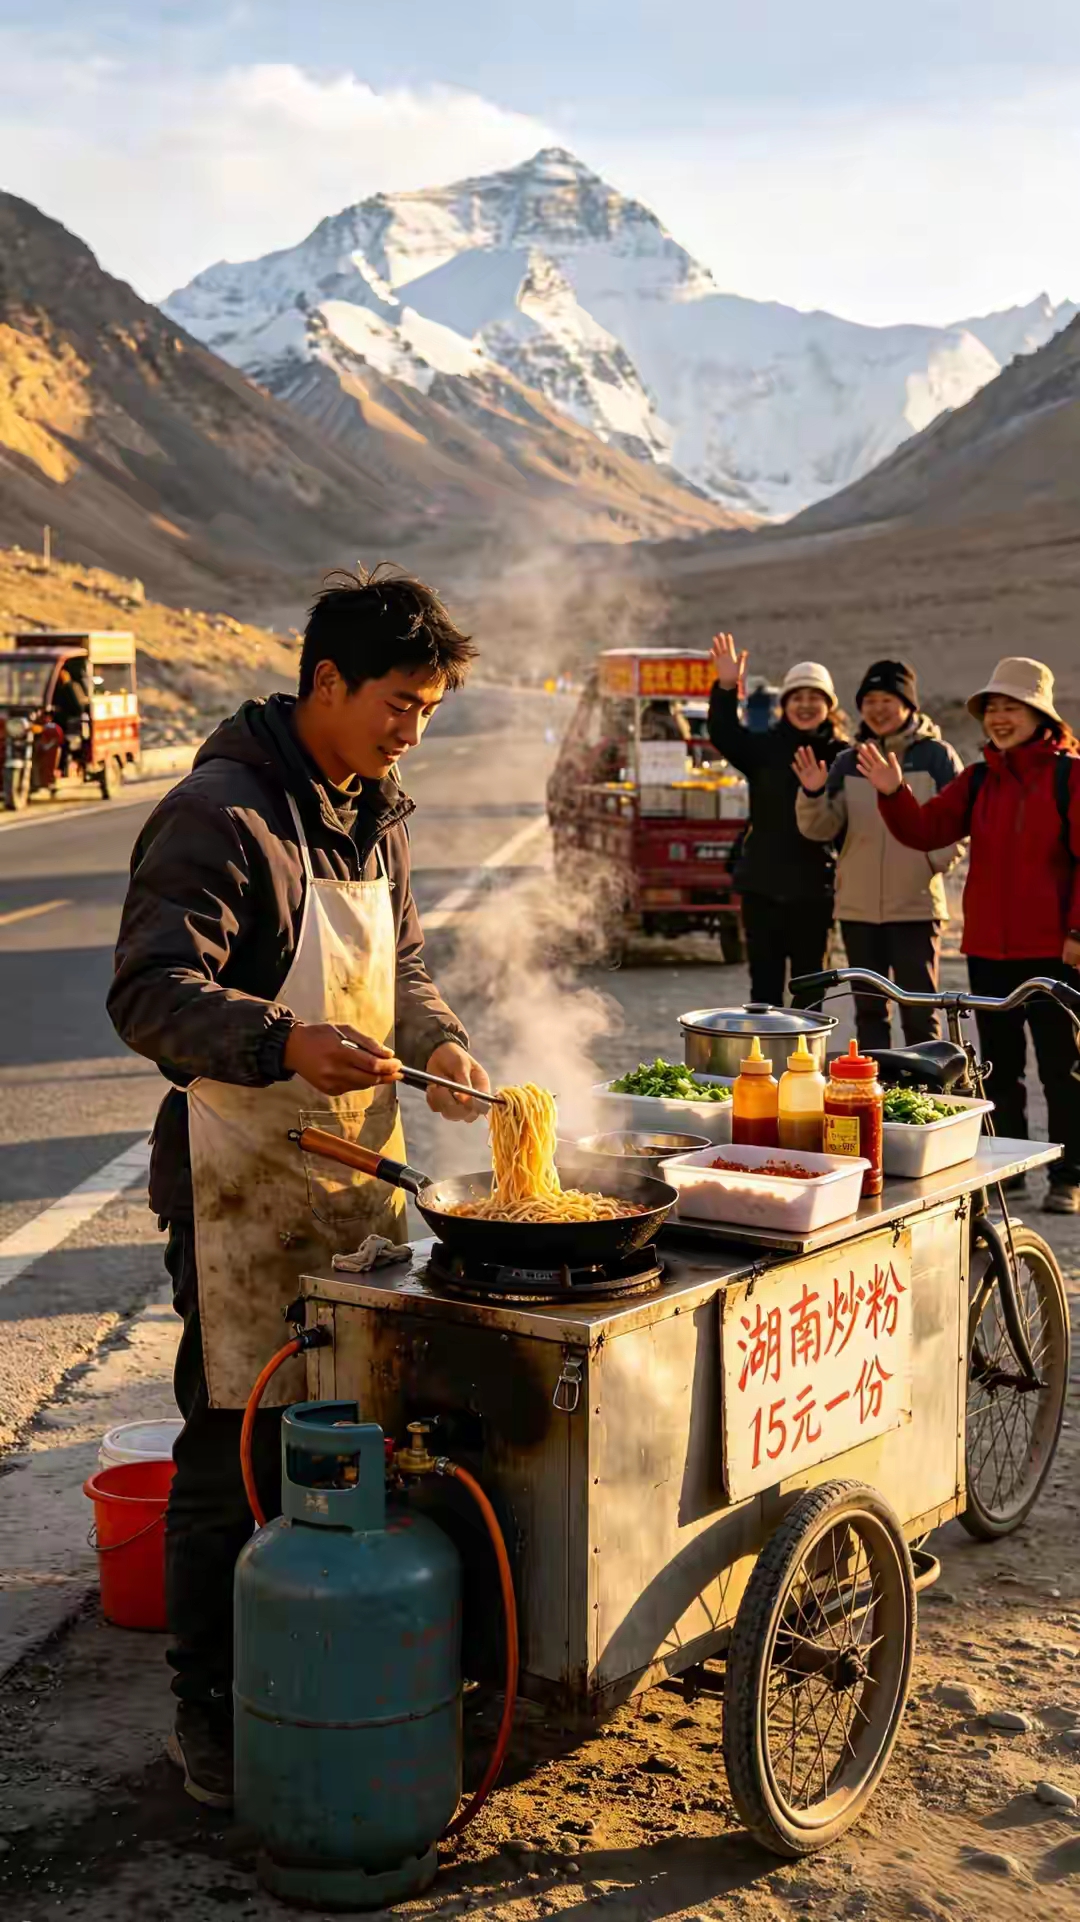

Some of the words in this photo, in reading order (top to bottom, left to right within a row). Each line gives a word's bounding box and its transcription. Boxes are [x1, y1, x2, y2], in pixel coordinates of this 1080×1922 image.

[737, 1261, 907, 1392] 湖南炒粉
[748, 1354, 894, 1470] 15元一份
